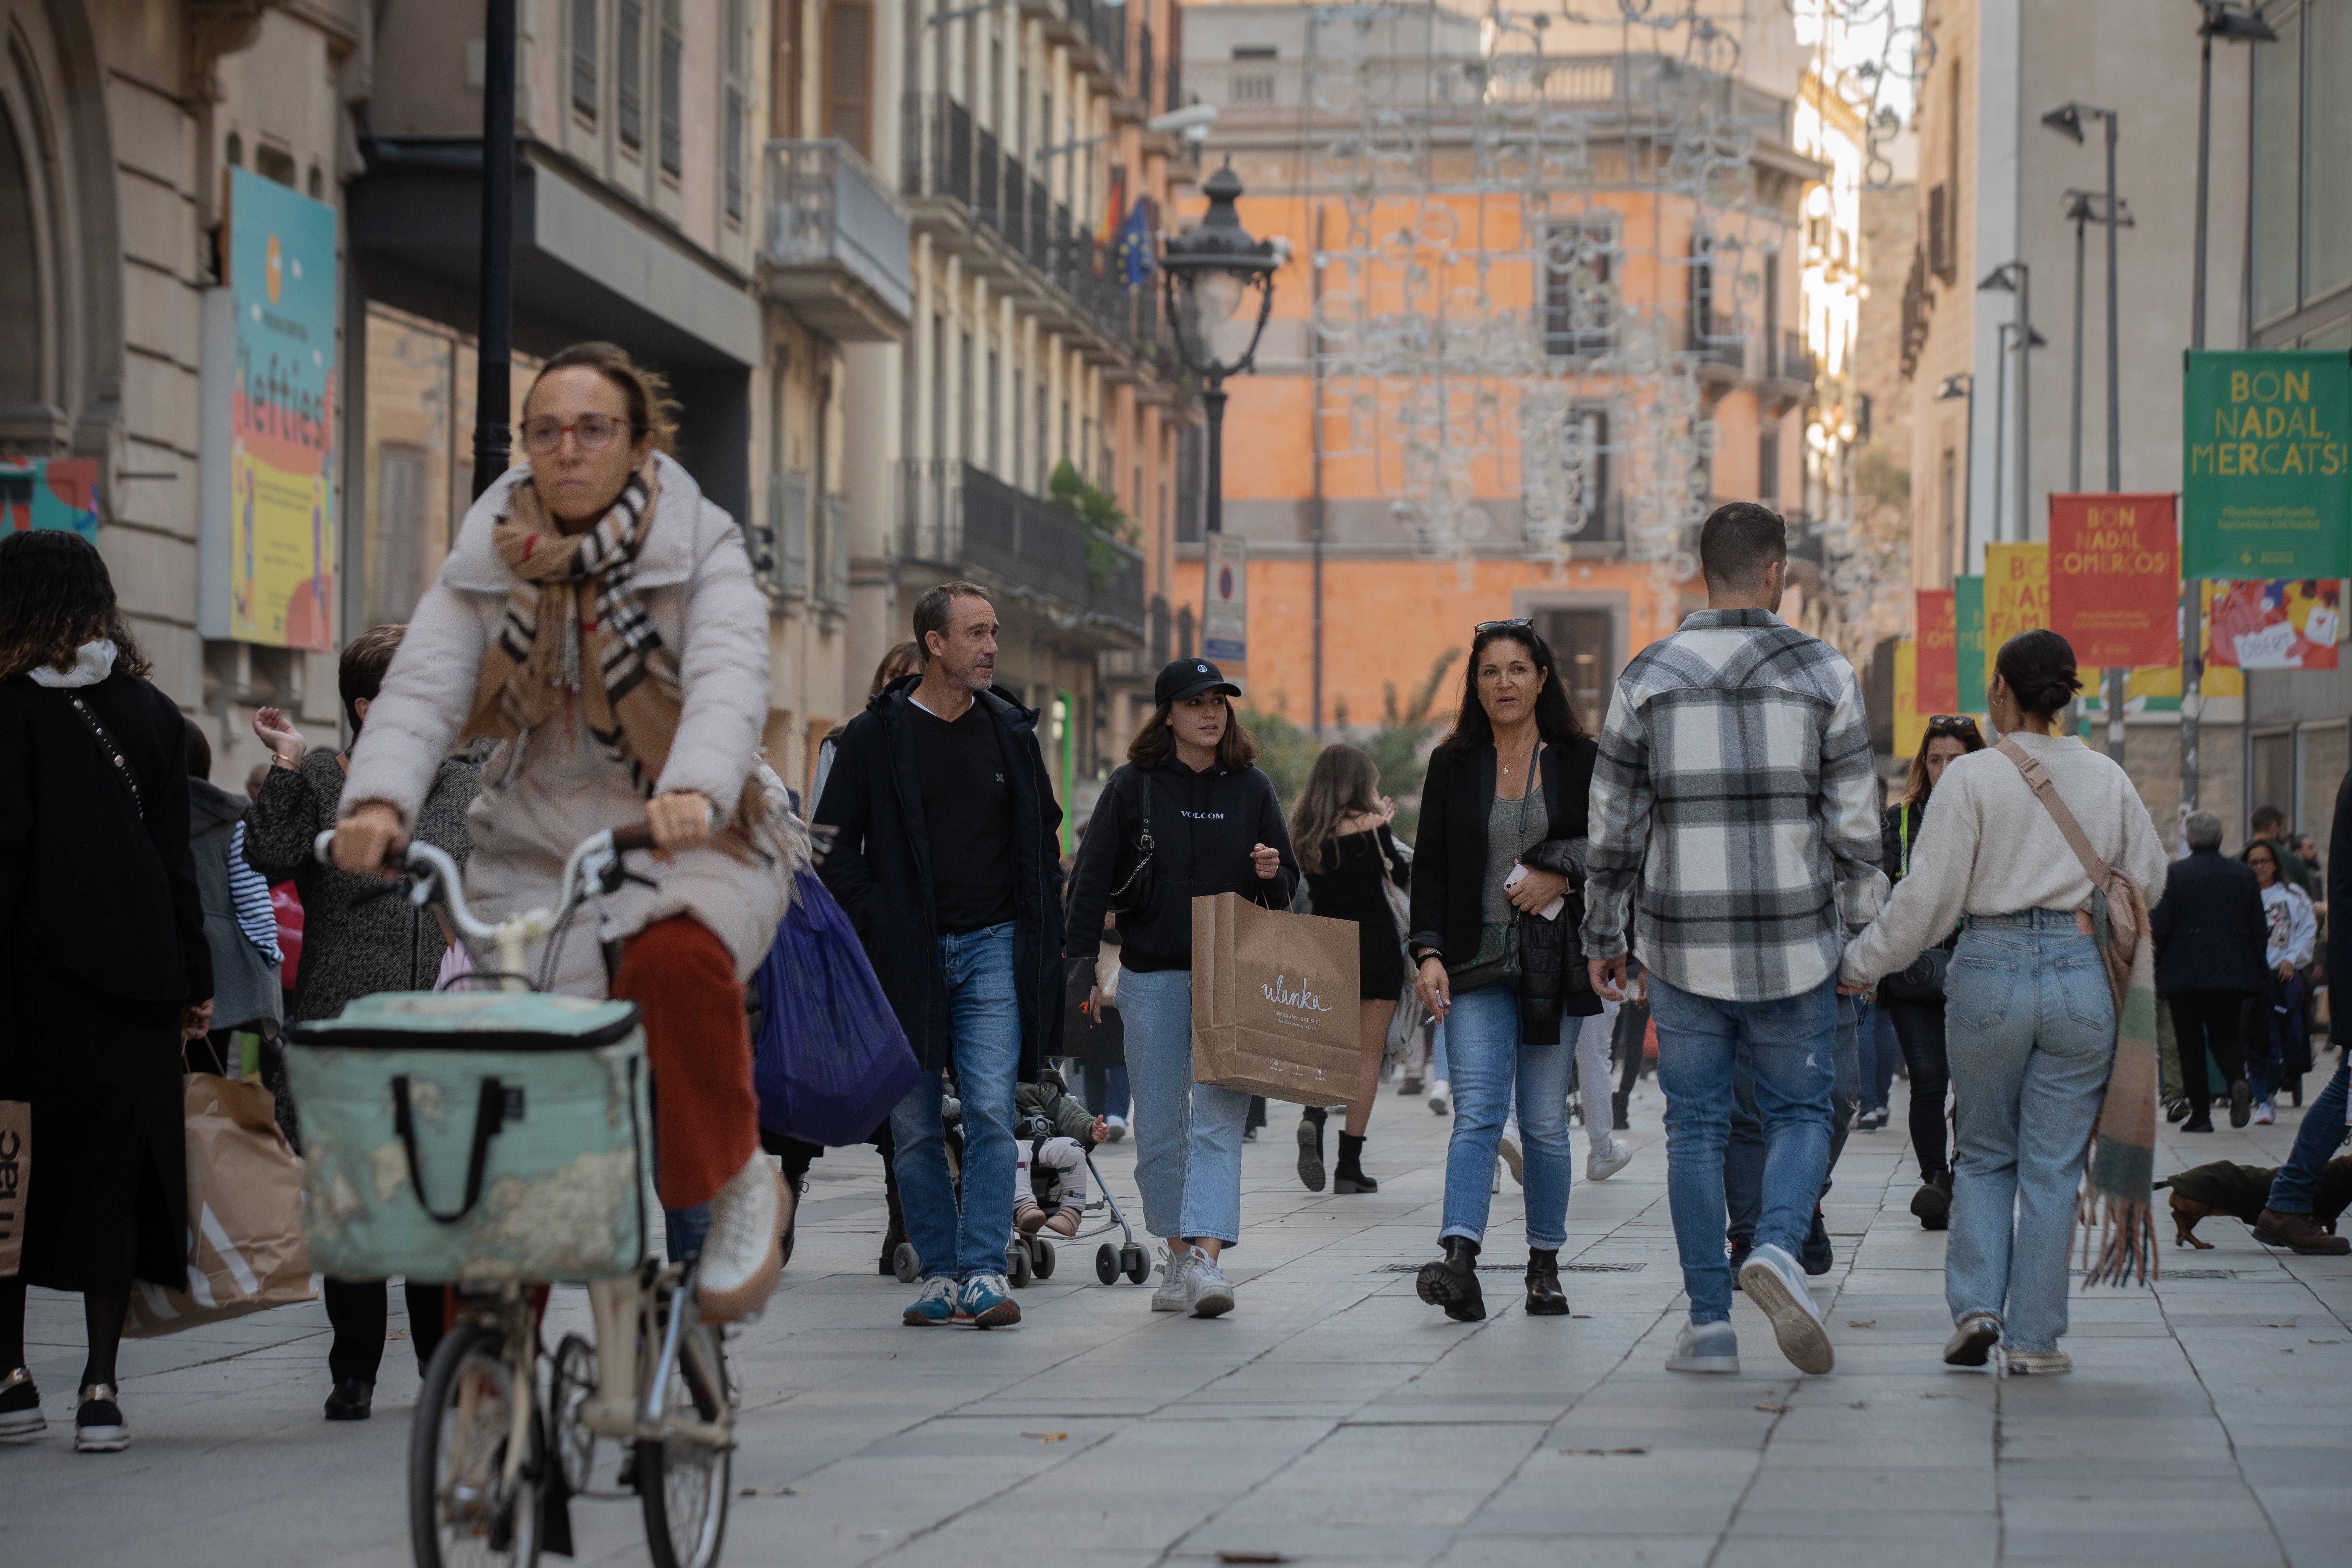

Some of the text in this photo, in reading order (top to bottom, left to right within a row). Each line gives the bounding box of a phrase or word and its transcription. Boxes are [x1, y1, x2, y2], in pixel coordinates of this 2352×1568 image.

[2231, 370, 2310, 403] BON
[2215, 406, 2331, 442] NADAL,
[2192, 442, 2348, 475] MERCATS!
[2087, 507, 2135, 528] BON
[1261, 974, 1332, 1011] ulanka
